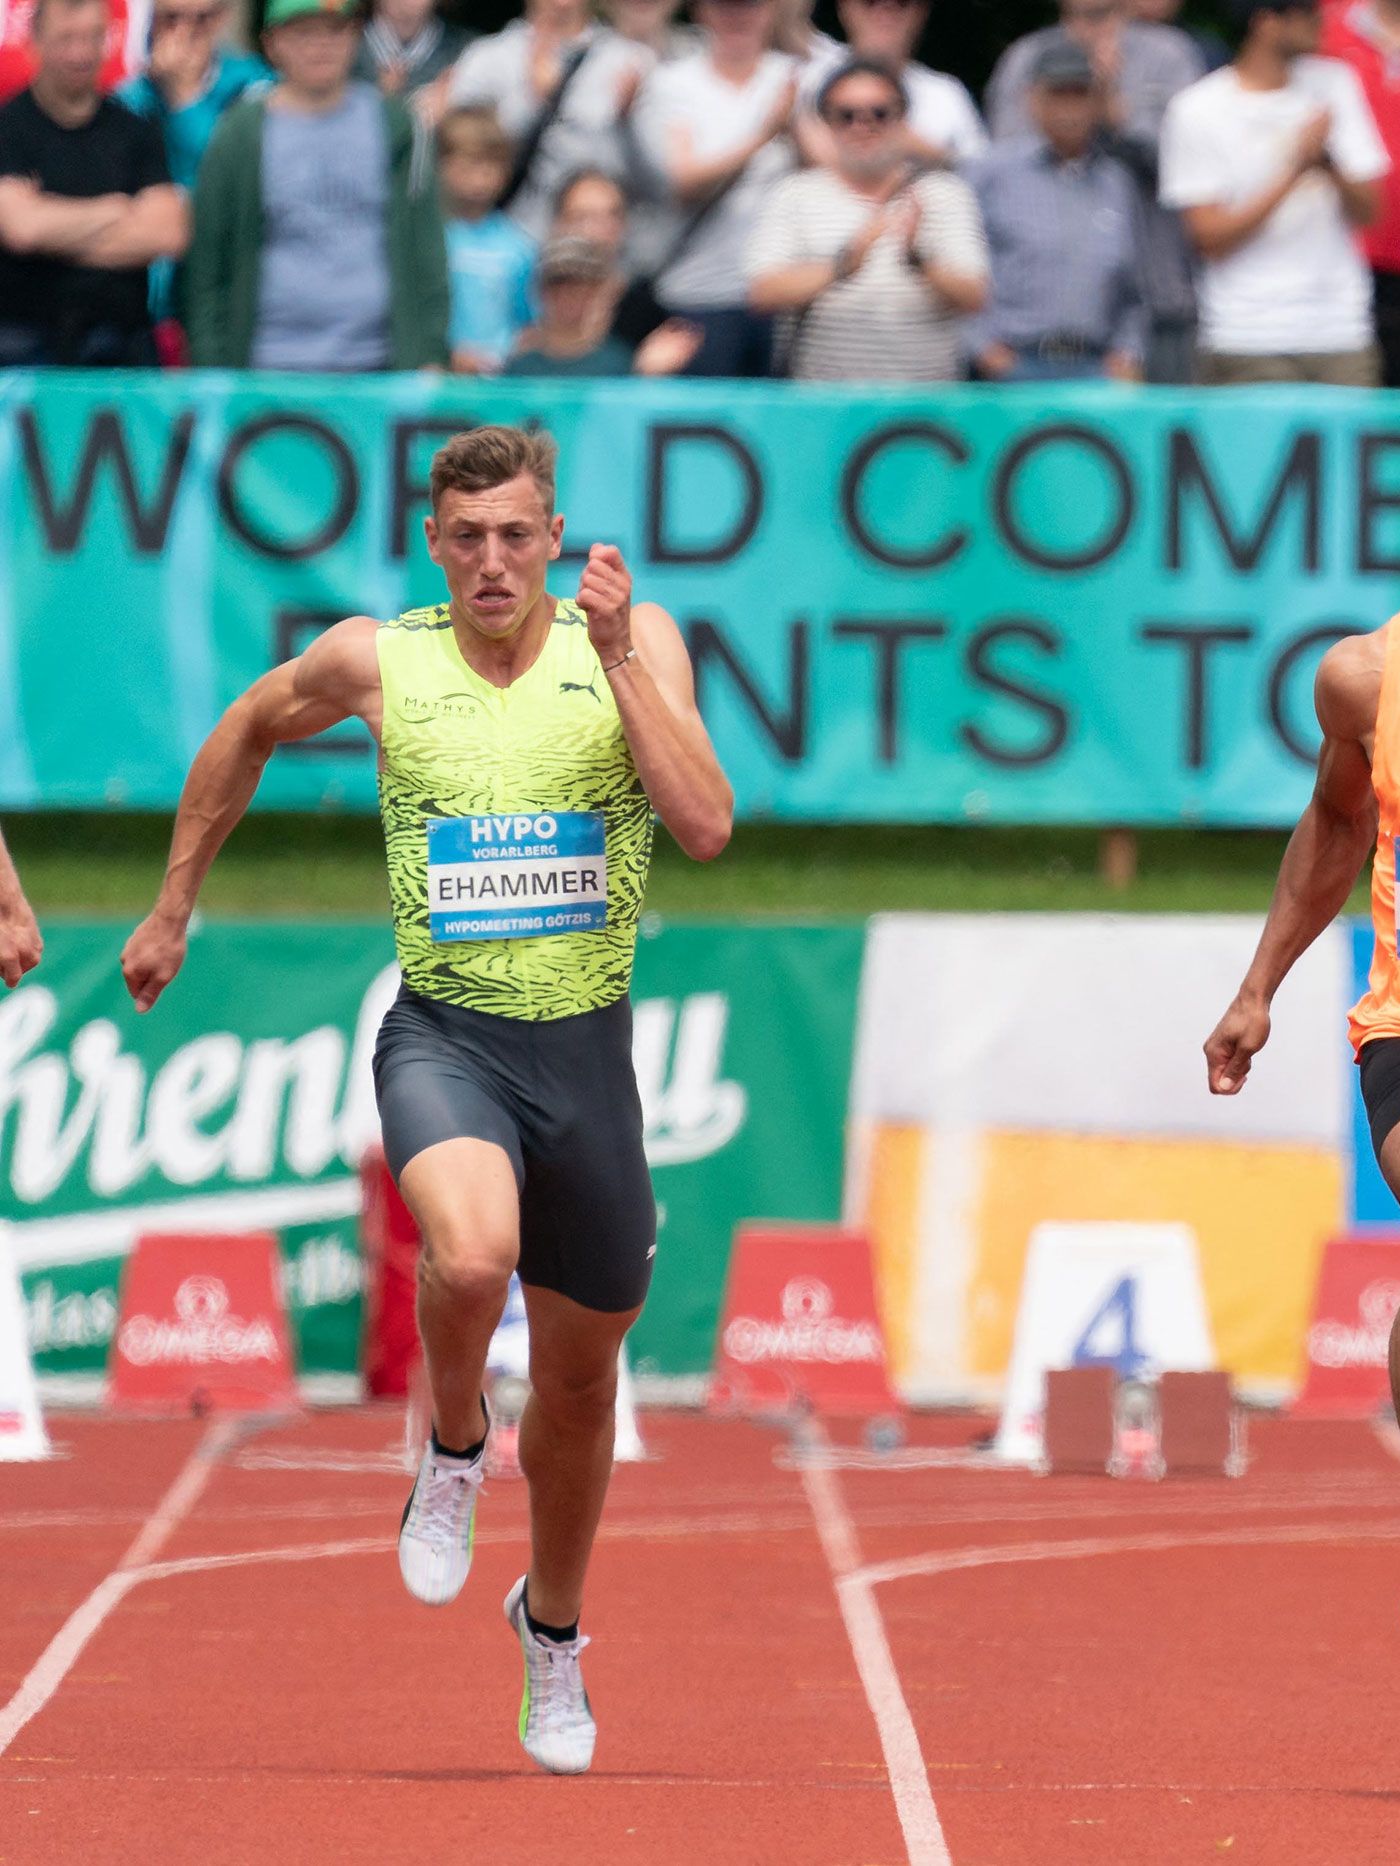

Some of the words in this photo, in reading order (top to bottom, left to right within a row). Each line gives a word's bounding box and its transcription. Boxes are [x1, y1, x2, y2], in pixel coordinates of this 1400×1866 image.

[17, 408, 764, 564] WORD
[275, 611, 1069, 766] ENTS
[471, 815, 558, 842] HYPO
[472, 844, 558, 859] VORARLBERG
[439, 869, 598, 900] EHAMMER
[445, 917, 543, 933] HYPOMEETING
[546, 912, 592, 928] GÖTZIS
[1072, 1275, 1154, 1380] 4
